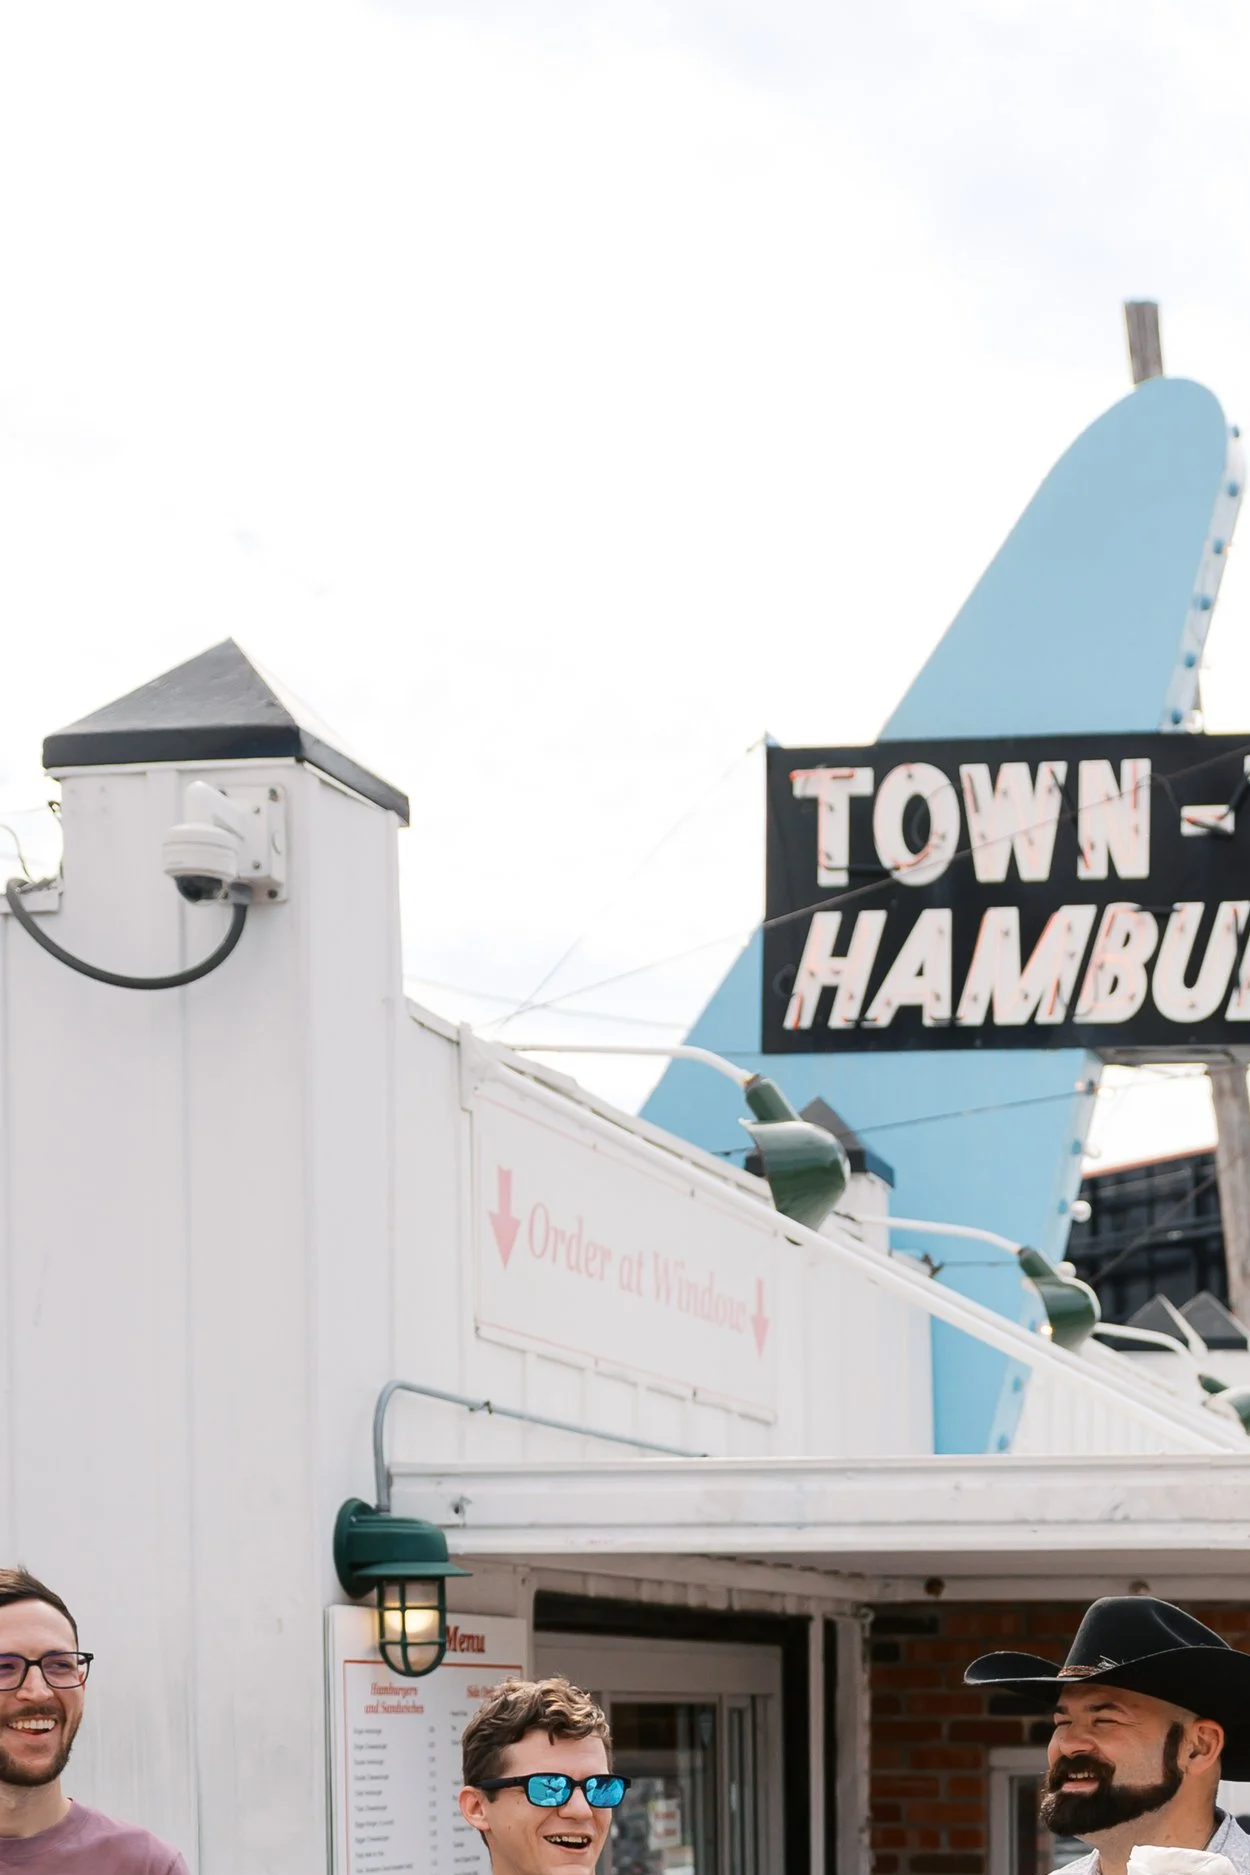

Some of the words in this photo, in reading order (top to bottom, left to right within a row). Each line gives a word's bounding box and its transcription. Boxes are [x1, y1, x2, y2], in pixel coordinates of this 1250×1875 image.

[790, 758, 1151, 887] TOWN
[527, 1202, 613, 1281] Order
[619, 1252, 644, 1298] at
[652, 1251, 747, 1333] Window
[446, 1624, 486, 1653] Menu
